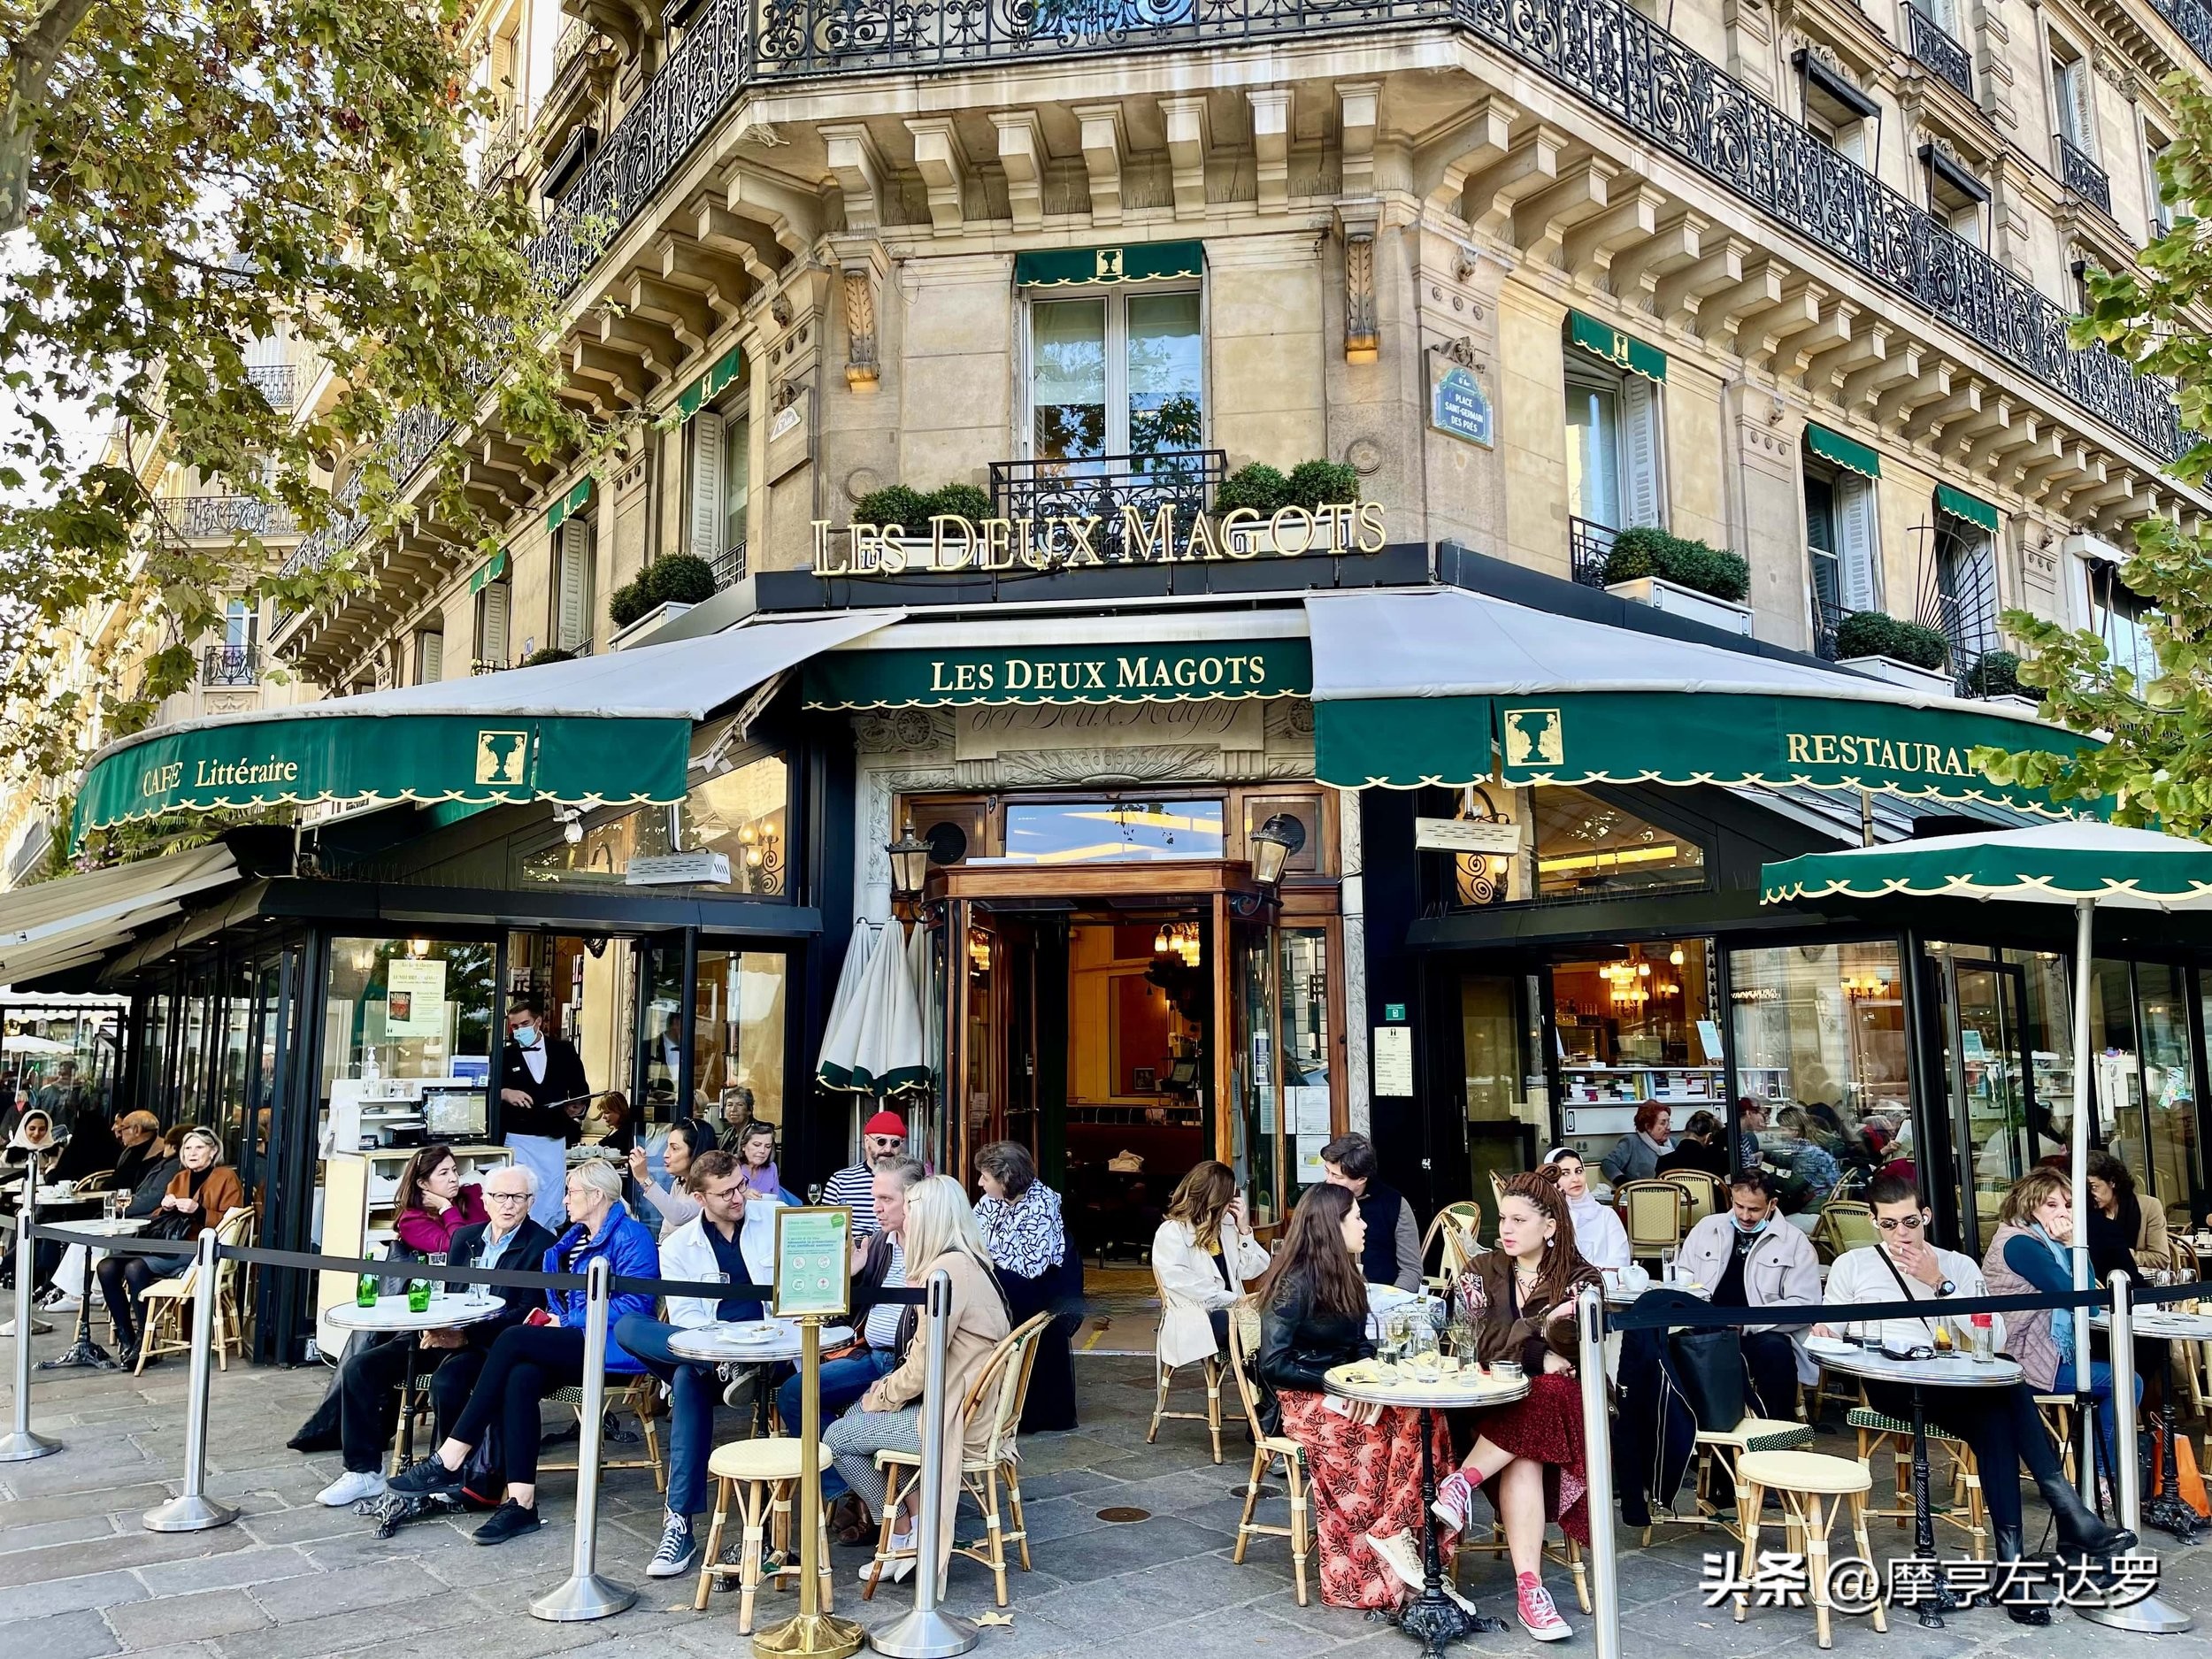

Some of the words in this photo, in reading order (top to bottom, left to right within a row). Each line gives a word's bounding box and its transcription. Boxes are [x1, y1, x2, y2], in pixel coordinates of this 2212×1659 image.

[1444, 401, 1483, 423] SAINT-GERMAIN
[1455, 393, 1472, 407] PLACE
[1451, 415, 1463, 426] DES
[1463, 419, 1478, 433] PRÉS
[810, 519, 909, 576] LES
[926, 514, 1105, 572] DEUX
[1118, 500, 1386, 563] MAGOTS
[930, 662, 995, 691] LES
[1004, 659, 1106, 690] DEUX
[1116, 656, 1266, 688] MAGOTS
[194, 754, 298, 787] Littéraire
